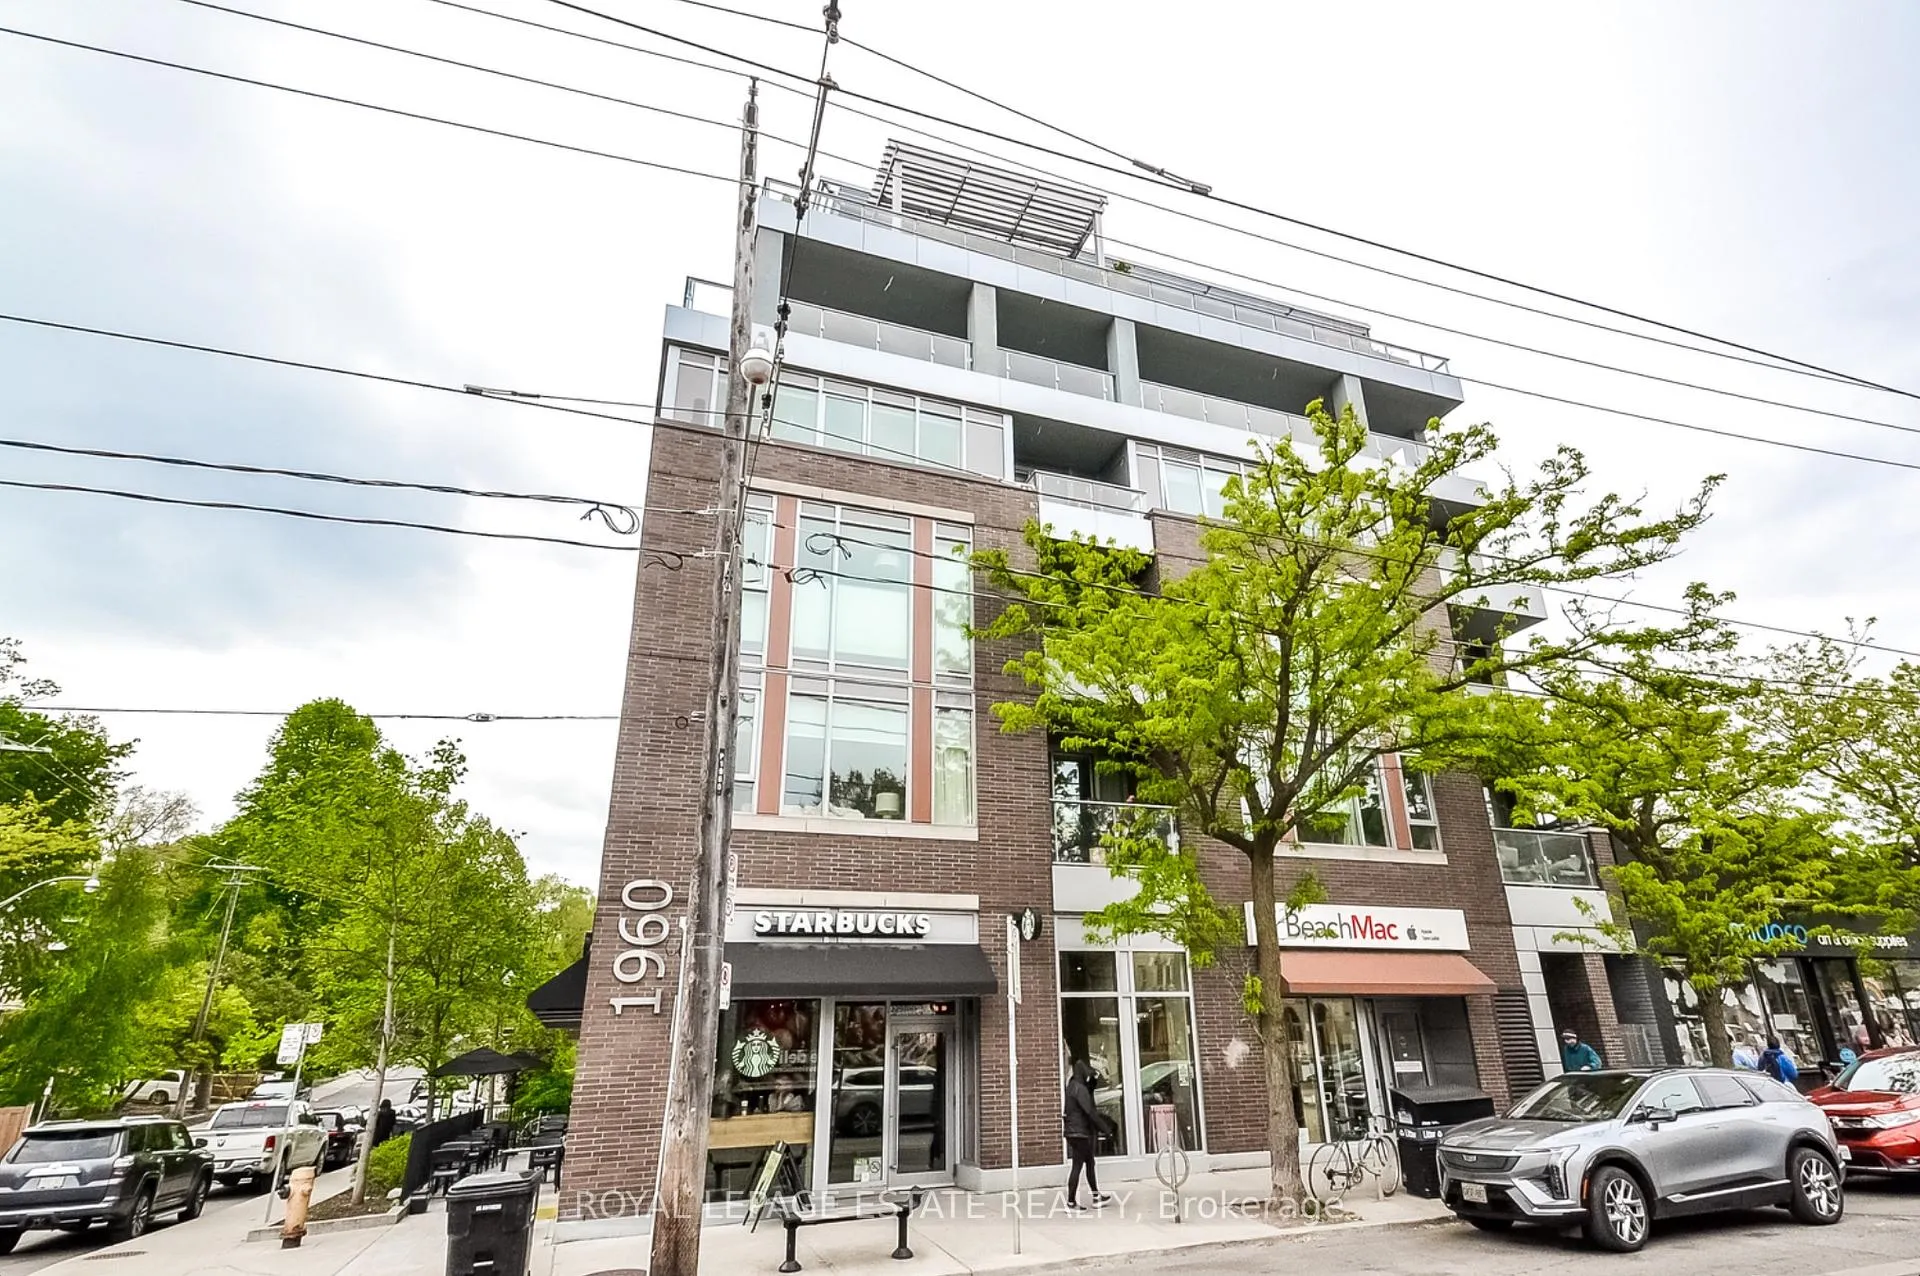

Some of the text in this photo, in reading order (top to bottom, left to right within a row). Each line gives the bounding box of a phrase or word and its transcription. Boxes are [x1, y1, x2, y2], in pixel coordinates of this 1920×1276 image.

[754, 911, 931, 935] STARBUCKS
[1285, 911, 1399, 940] BeachMac
[609, 879, 673, 1015] 1960
